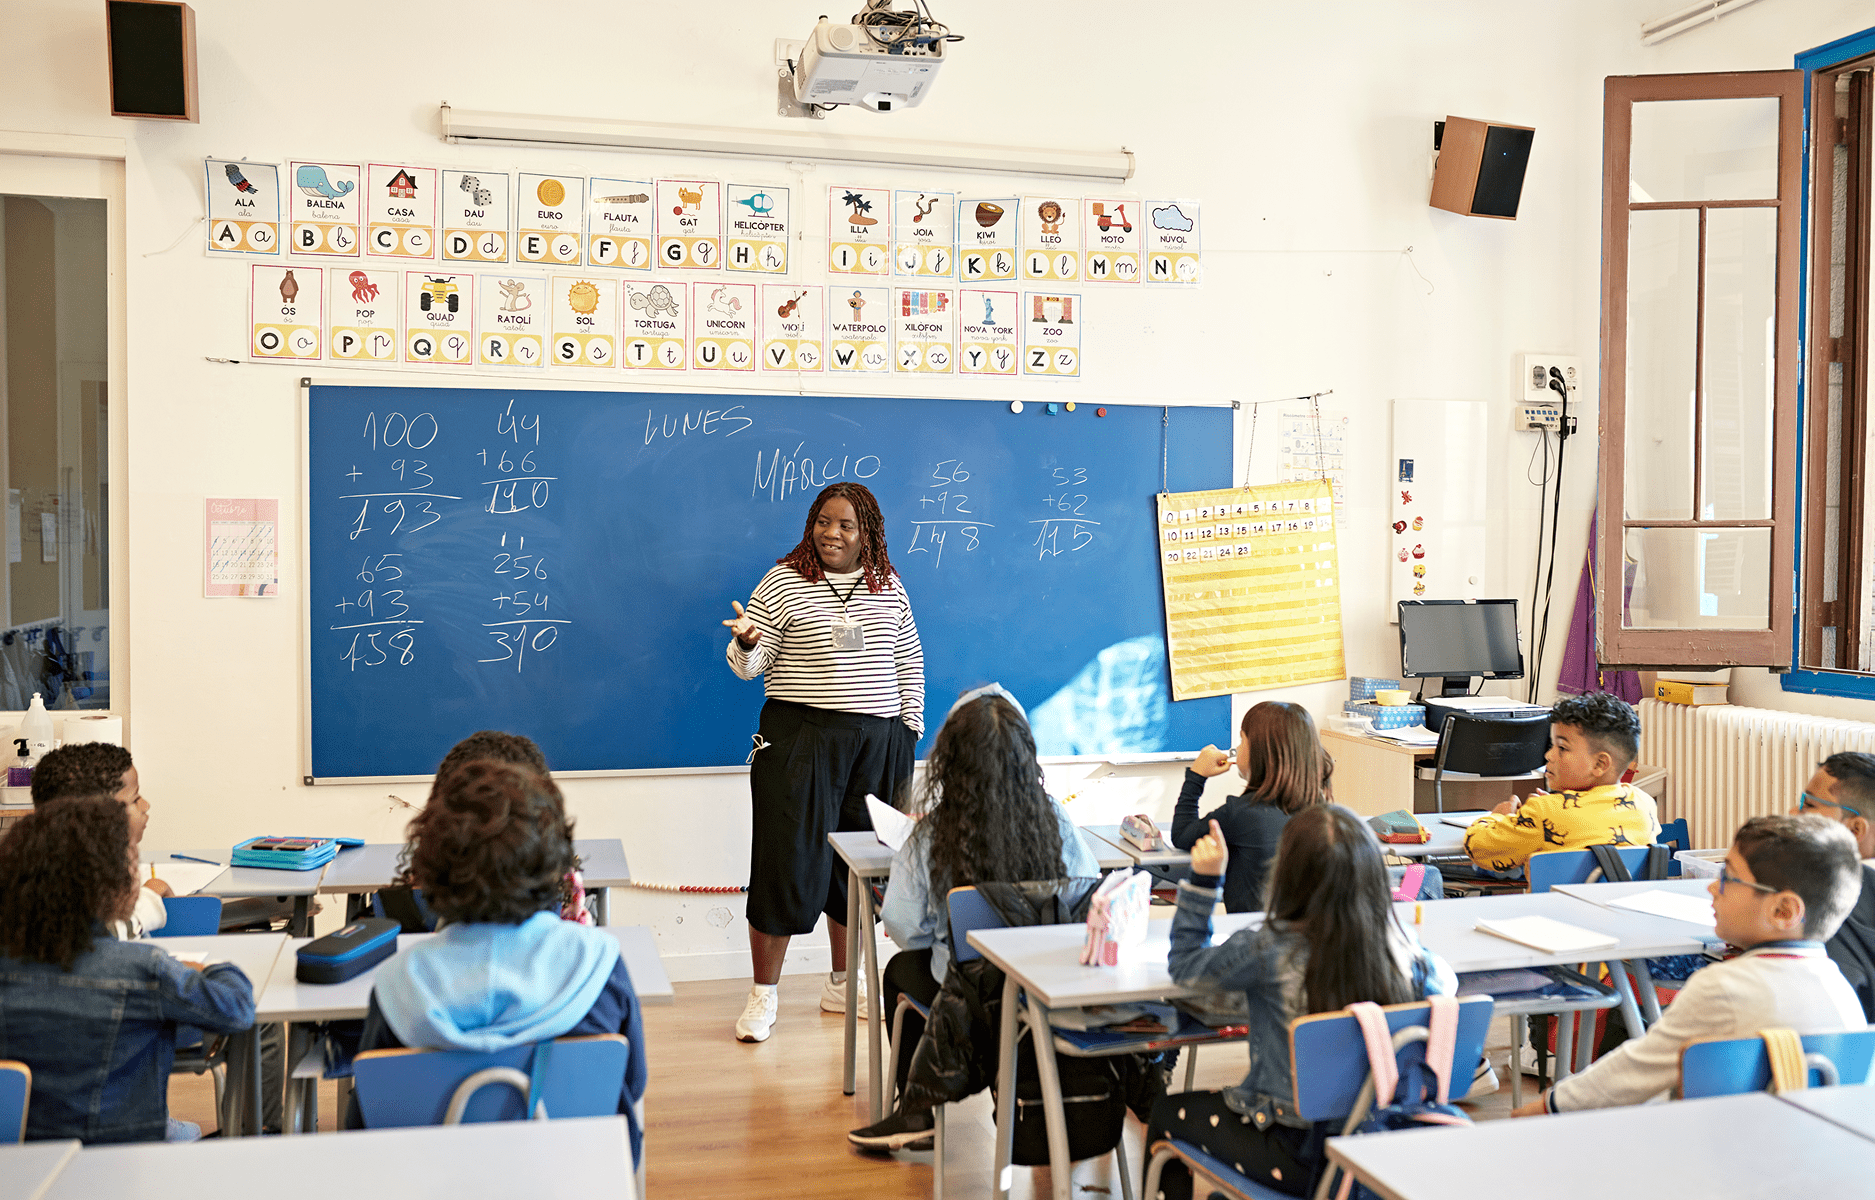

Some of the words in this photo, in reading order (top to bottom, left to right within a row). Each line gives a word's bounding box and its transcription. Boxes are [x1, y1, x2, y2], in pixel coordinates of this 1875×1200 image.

[235, 199, 255, 207] ALA
[306, 199, 345, 209] BALENA
[238, 209, 252, 217] ala
[312, 211, 340, 220] balena
[388, 207, 415, 217] CASA
[464, 209, 484, 218] DAU
[538, 211, 563, 219] EURO
[603, 213, 638, 223] FLAUTA
[466, 218, 482, 227] dau
[609, 224, 631, 233] flauta
[680, 218, 698, 226] GAT
[734, 220, 784, 232] HELICÒPTER
[850, 226, 868, 234] ILLA
[219, 224, 235, 242] A
[254, 230, 271, 242] a
[303, 230, 314, 246] B
[337, 227, 351, 247] b
[377, 231, 392, 248] C
[411, 235, 423, 246] c
[913, 229, 934, 237] JOIA
[1040, 233, 1061, 243] LLEÓ
[1160, 233, 1187, 243] NÚVOL
[454, 237, 467, 254] D
[483, 233, 499, 253] d
[528, 237, 539, 254] E
[559, 244, 572, 255] e
[599, 241, 611, 257] F
[631, 241, 639, 264] f
[667, 244, 681, 260] G
[698, 243, 712, 263] g
[736, 247, 748, 263] H
[767, 246, 781, 267] h
[869, 253, 877, 266] i
[905, 253, 917, 268] J
[935, 250, 944, 272] j
[968, 257, 981, 273] K
[996, 253, 1010, 272] k
[1033, 258, 1042, 273] L
[1062, 255, 1069, 275] l
[1093, 259, 1105, 274] M
[1116, 263, 1137, 273] m
[1155, 259, 1166, 274] N
[1180, 263, 1196, 274] n
[356, 309, 375, 318] POP
[426, 312, 454, 321] QUAD
[497, 314, 531, 324] RATOLÍ
[576, 317, 595, 325] SOL
[634, 320, 676, 329] TORTUGA
[706, 320, 745, 329] UNICORN
[833, 323, 886, 332] WATERPOLO
[905, 322, 943, 331] XILÒFON
[992, 327, 1013, 335] YORK
[260, 332, 279, 349] O
[343, 336, 353, 352] P
[374, 335, 390, 356] p
[413, 338, 431, 356] Q
[448, 336, 464, 358] q
[491, 340, 502, 357] R
[520, 346, 534, 358] r
[561, 342, 574, 359] S
[593, 347, 606, 359] s
[634, 344, 644, 360] T
[666, 347, 676, 363] t
[703, 346, 715, 362] U
[732, 351, 747, 362] u
[771, 349, 785, 365] V
[800, 352, 817, 363] v
[835, 350, 854, 365] W
[863, 353, 886, 364] w
[903, 350, 917, 366] X
[930, 353, 947, 364] x
[968, 351, 981, 367] Y
[996, 349, 1009, 369] y
[1032, 351, 1045, 367] Z
[1058, 354, 1072, 365] z
[363, 411, 438, 450] 100
[498, 412, 539, 445] 44
[645, 405, 752, 445] LUNES
[930, 459, 970, 487] 56
[1052, 467, 1088, 486] 53
[349, 499, 441, 540] 193
[1166, 512, 1173, 523] 0
[1219, 508, 1225, 516] 3
[1272, 503, 1277, 511] 6
[1168, 531, 1177, 541] 10
[1185, 531, 1194, 540] 11
[1201, 530, 1212, 538] 12
[1219, 527, 1229, 536] 13
[1236, 526, 1247, 535] 15
[1253, 525, 1263, 533] 14
[1271, 524, 1281, 532] 17
[1288, 523, 1298, 531] 16
[1168, 553, 1179, 561] 20
[1186, 552, 1197, 560] 22
[1219, 548, 1230, 557] 24
[1238, 546, 1248, 555] 23
[356, 554, 402, 583] 65
[494, 553, 547, 580] 256
[478, 625, 558, 673] 310
